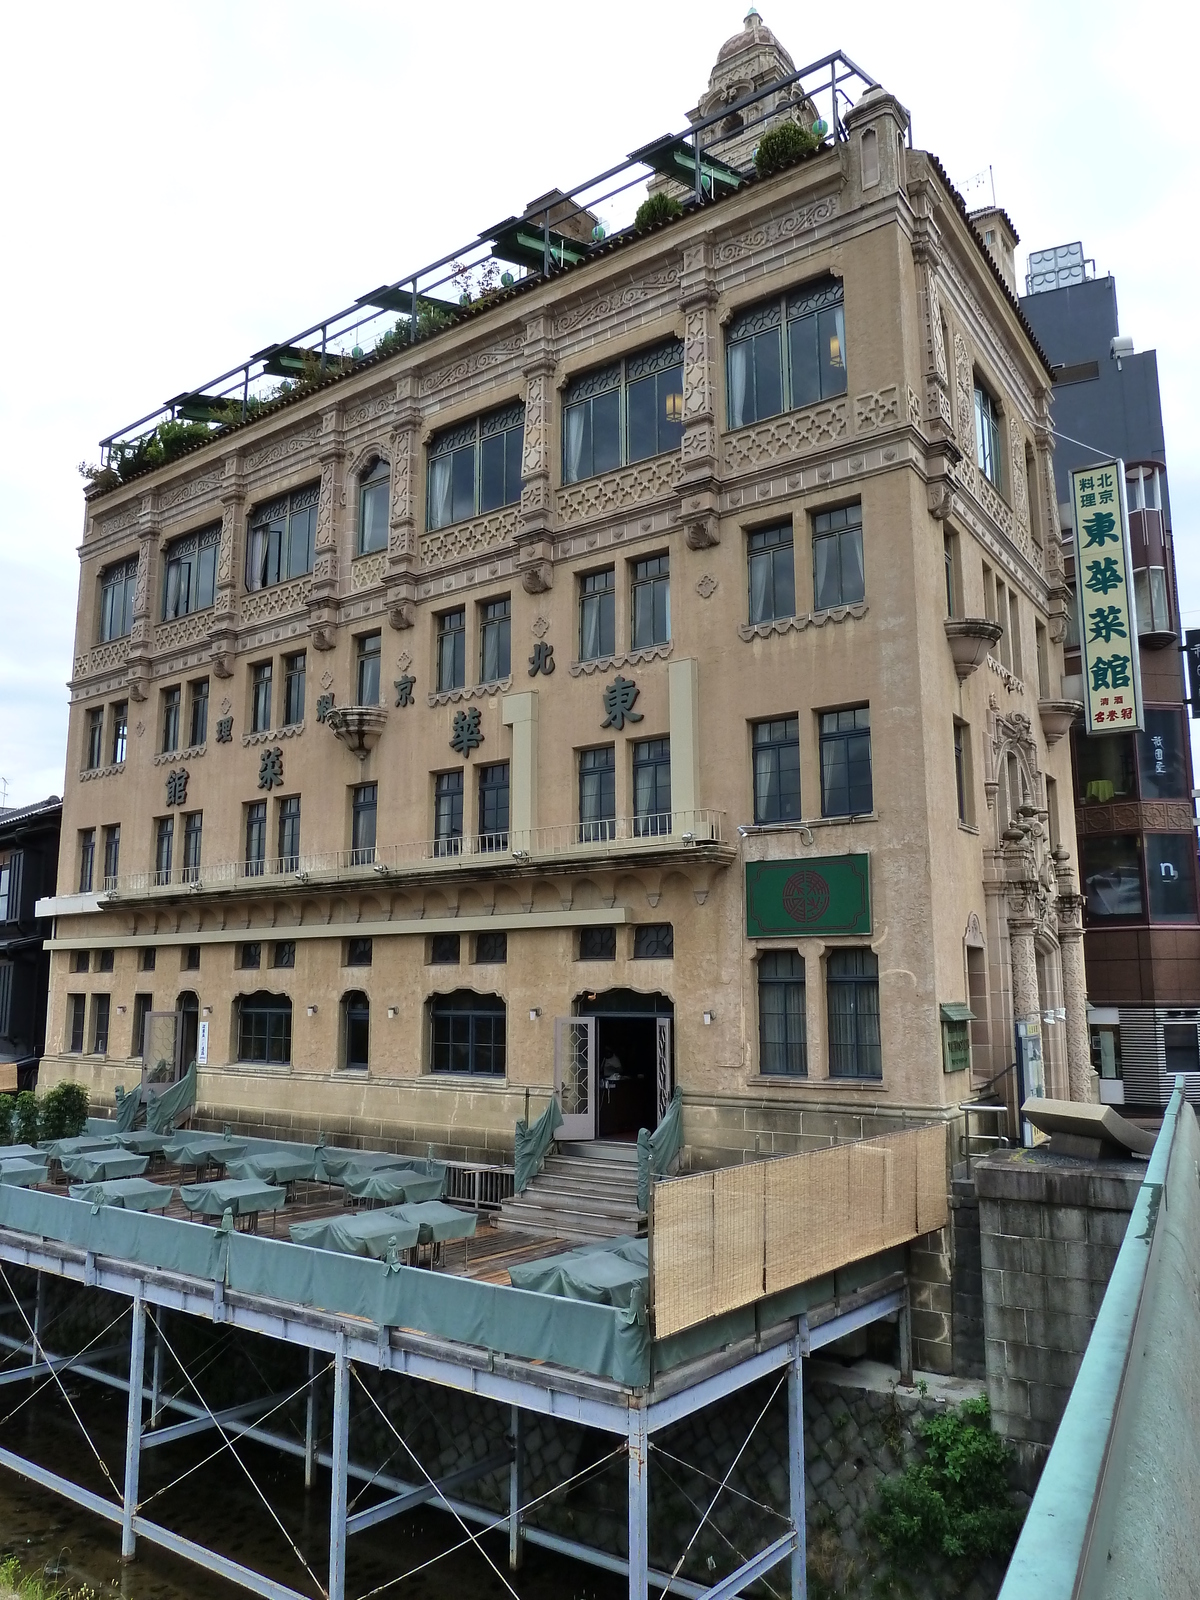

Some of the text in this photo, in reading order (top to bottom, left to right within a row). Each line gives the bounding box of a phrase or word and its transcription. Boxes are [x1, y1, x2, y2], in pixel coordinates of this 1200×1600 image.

[1079, 476, 1096, 508] 料理
[1097, 473, 1115, 504] 北京
[1082, 511, 1131, 692] 東華菜館
